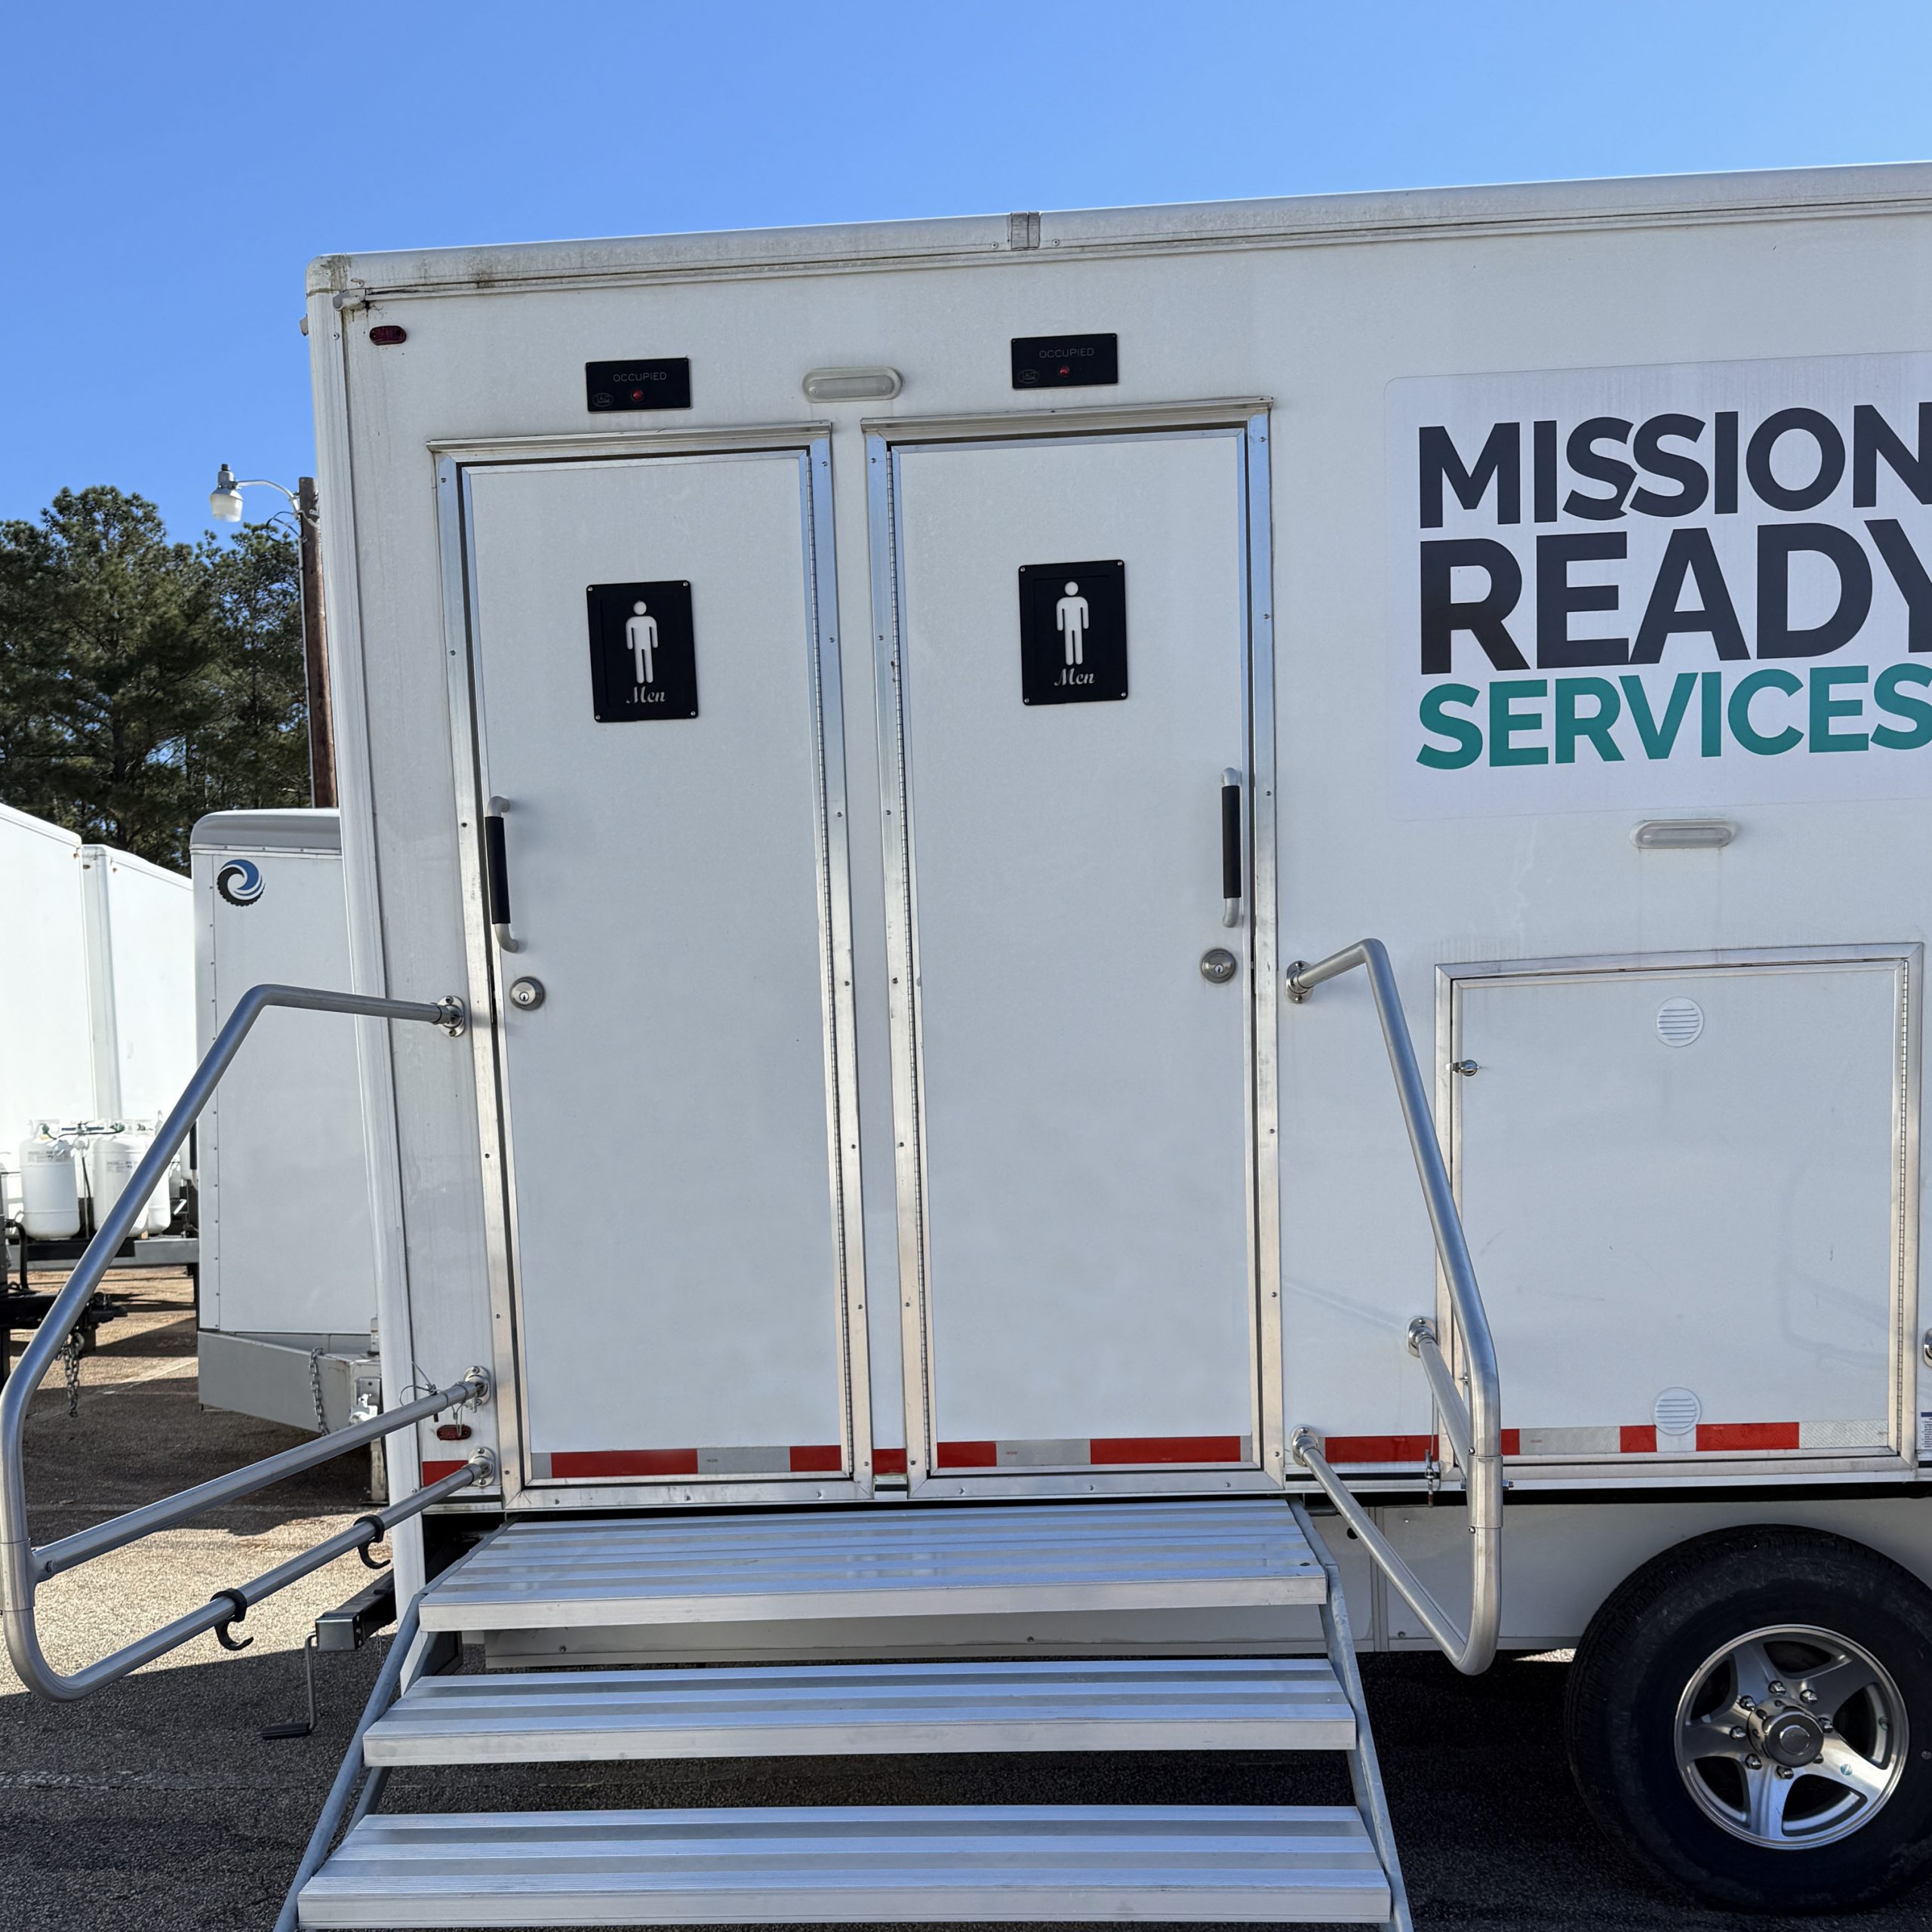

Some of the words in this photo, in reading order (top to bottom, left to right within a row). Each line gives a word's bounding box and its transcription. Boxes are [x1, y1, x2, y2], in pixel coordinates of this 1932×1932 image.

[1039, 347, 1094, 358] OCCUPIED
[614, 371, 667, 382] OCCUPIED
[1420, 402, 1932, 528] MISSION
[1054, 667, 1095, 686] Men
[626, 686, 666, 703] Men
[1417, 663, 1932, 769] SERVICES
